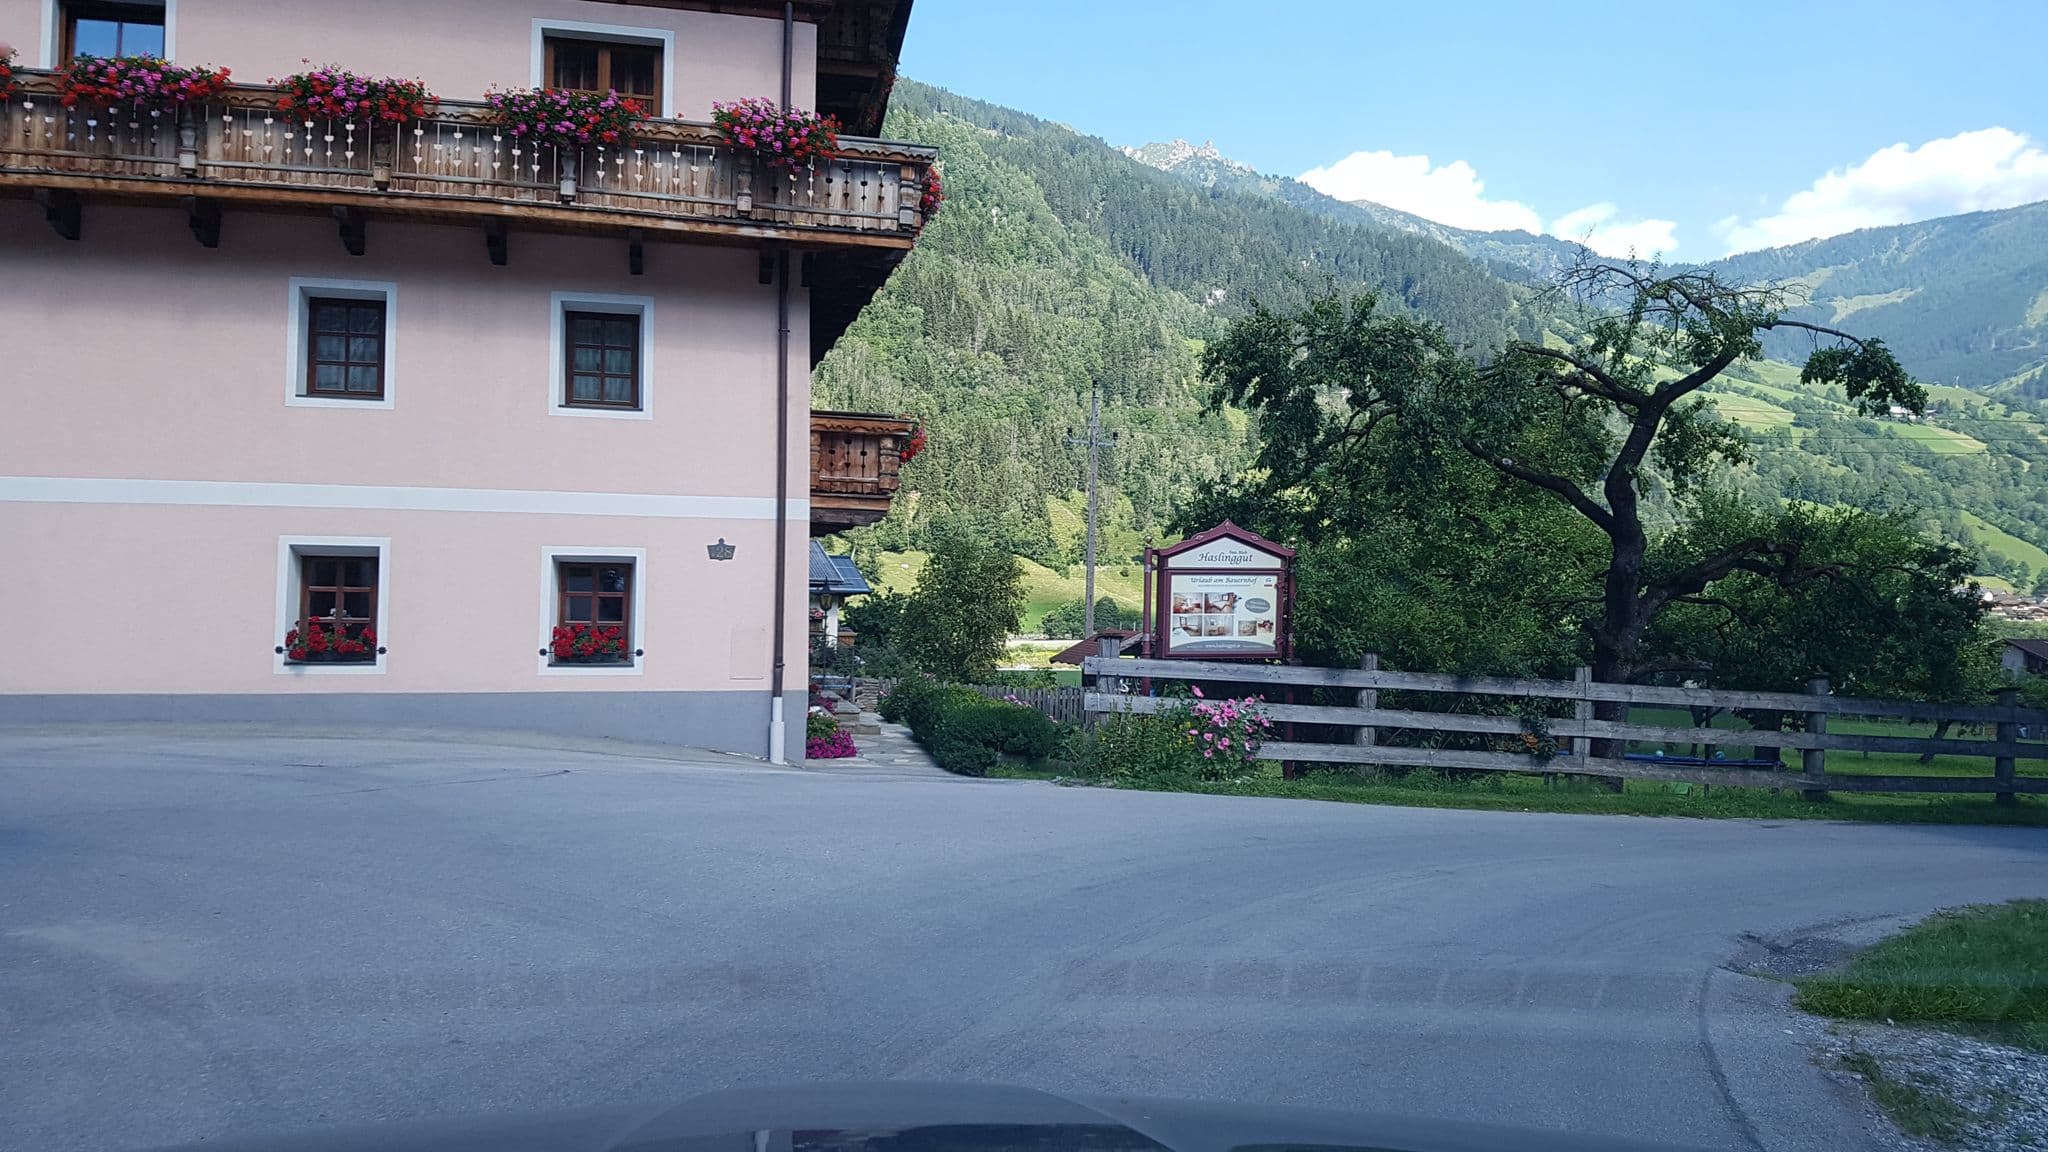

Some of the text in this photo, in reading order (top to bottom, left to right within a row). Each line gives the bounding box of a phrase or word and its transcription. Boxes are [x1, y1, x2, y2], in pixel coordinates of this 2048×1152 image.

[716, 546, 733, 558] 28
[1198, 551, 1253, 565] Haslinggut
[1225, 576, 1258, 585] Bauernhof
